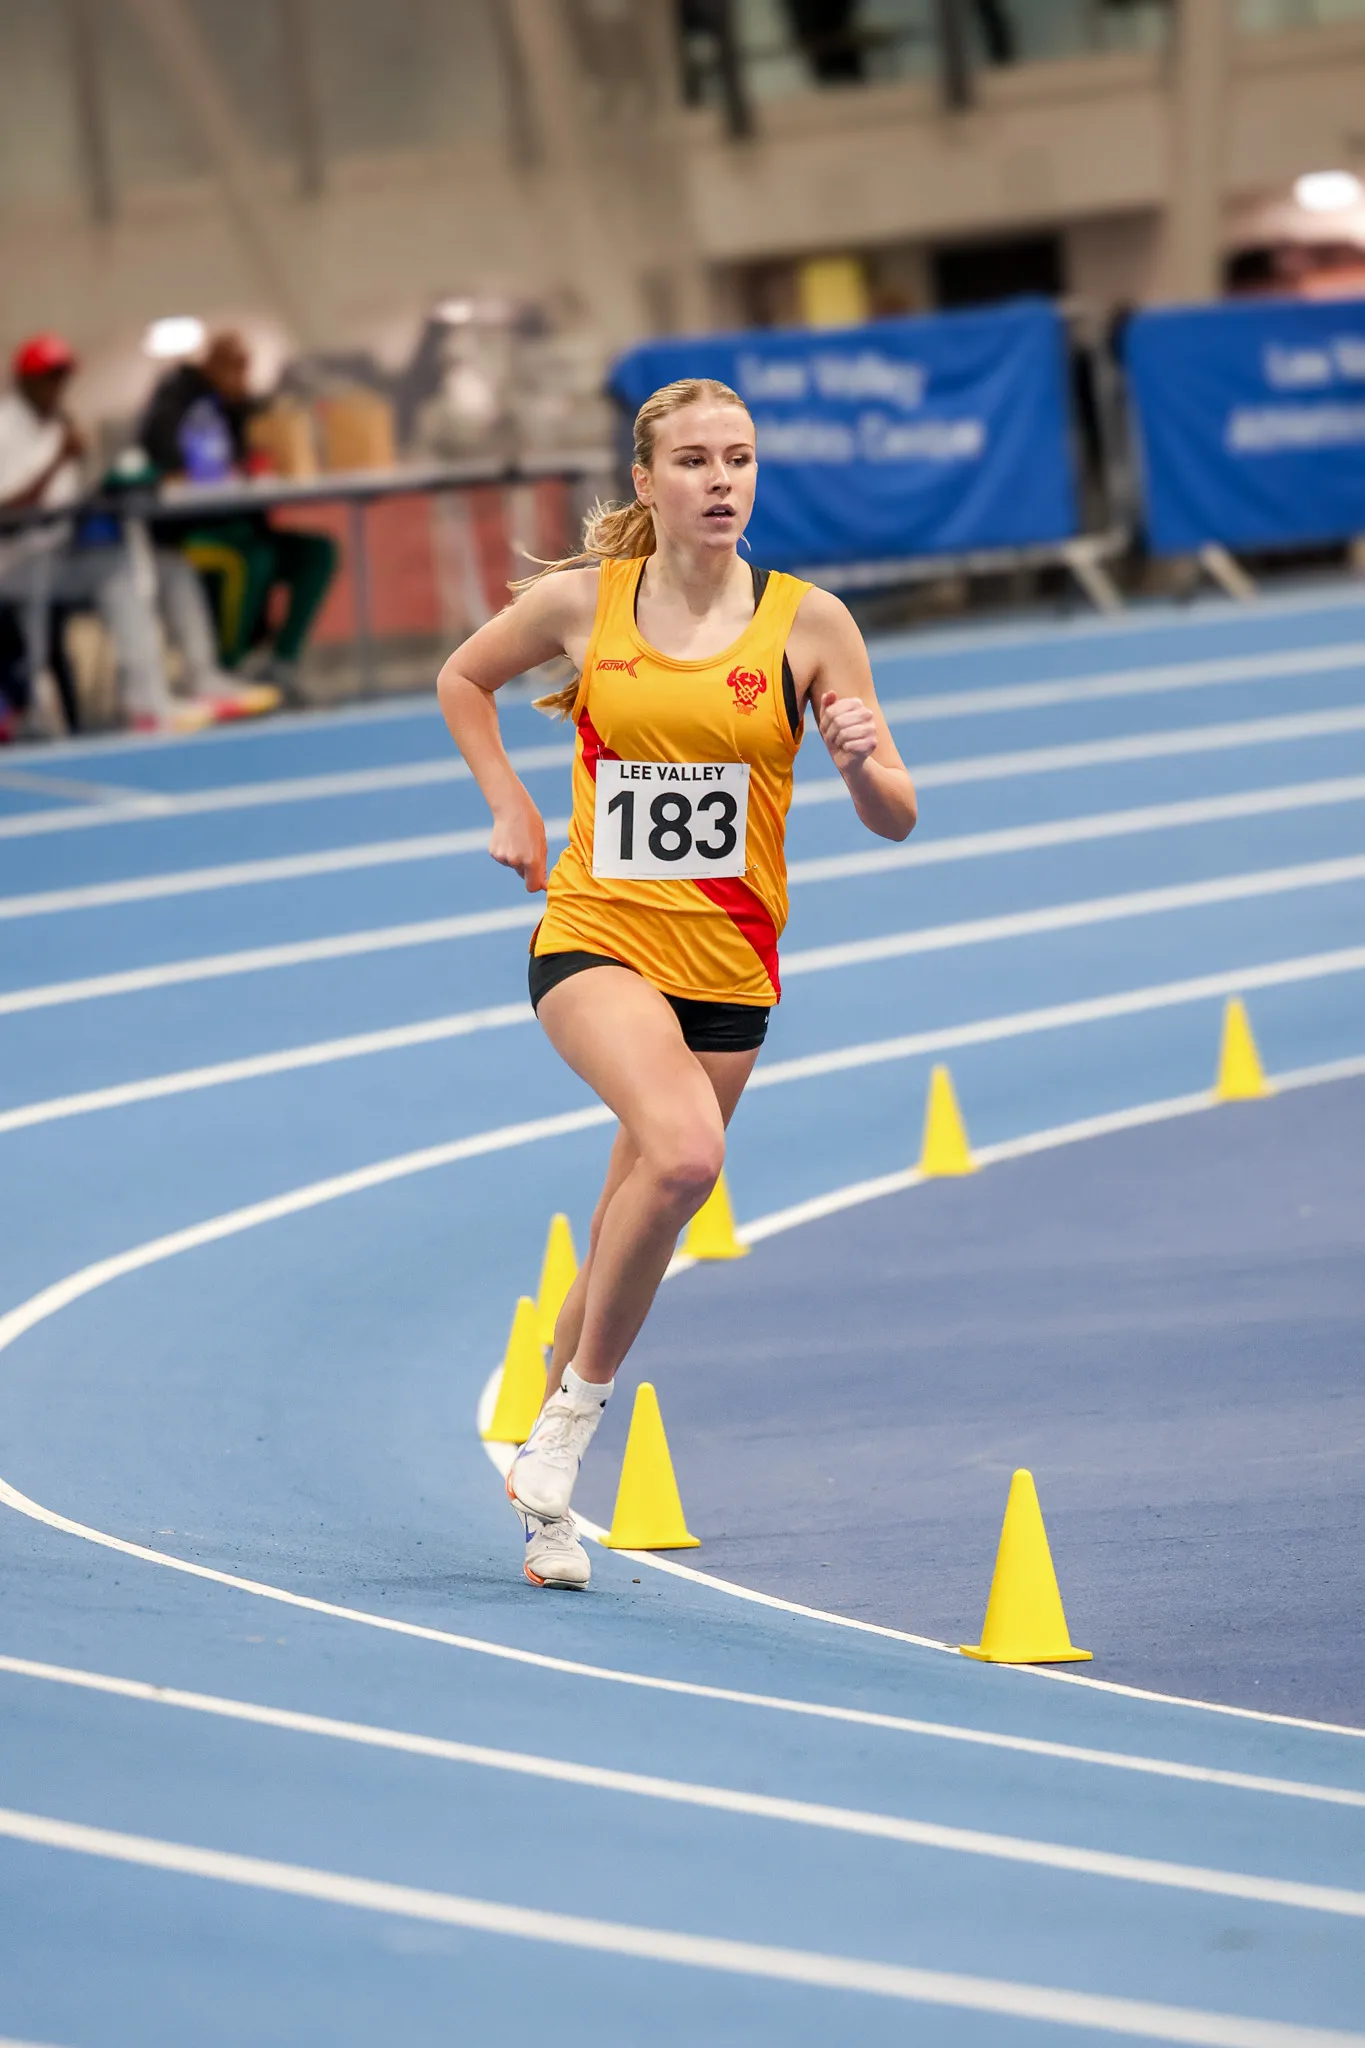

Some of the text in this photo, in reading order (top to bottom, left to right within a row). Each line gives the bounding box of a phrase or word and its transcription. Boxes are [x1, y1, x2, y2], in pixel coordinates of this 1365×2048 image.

[620, 764, 726, 781] LEE VALLEY
[608, 790, 738, 862] 183
